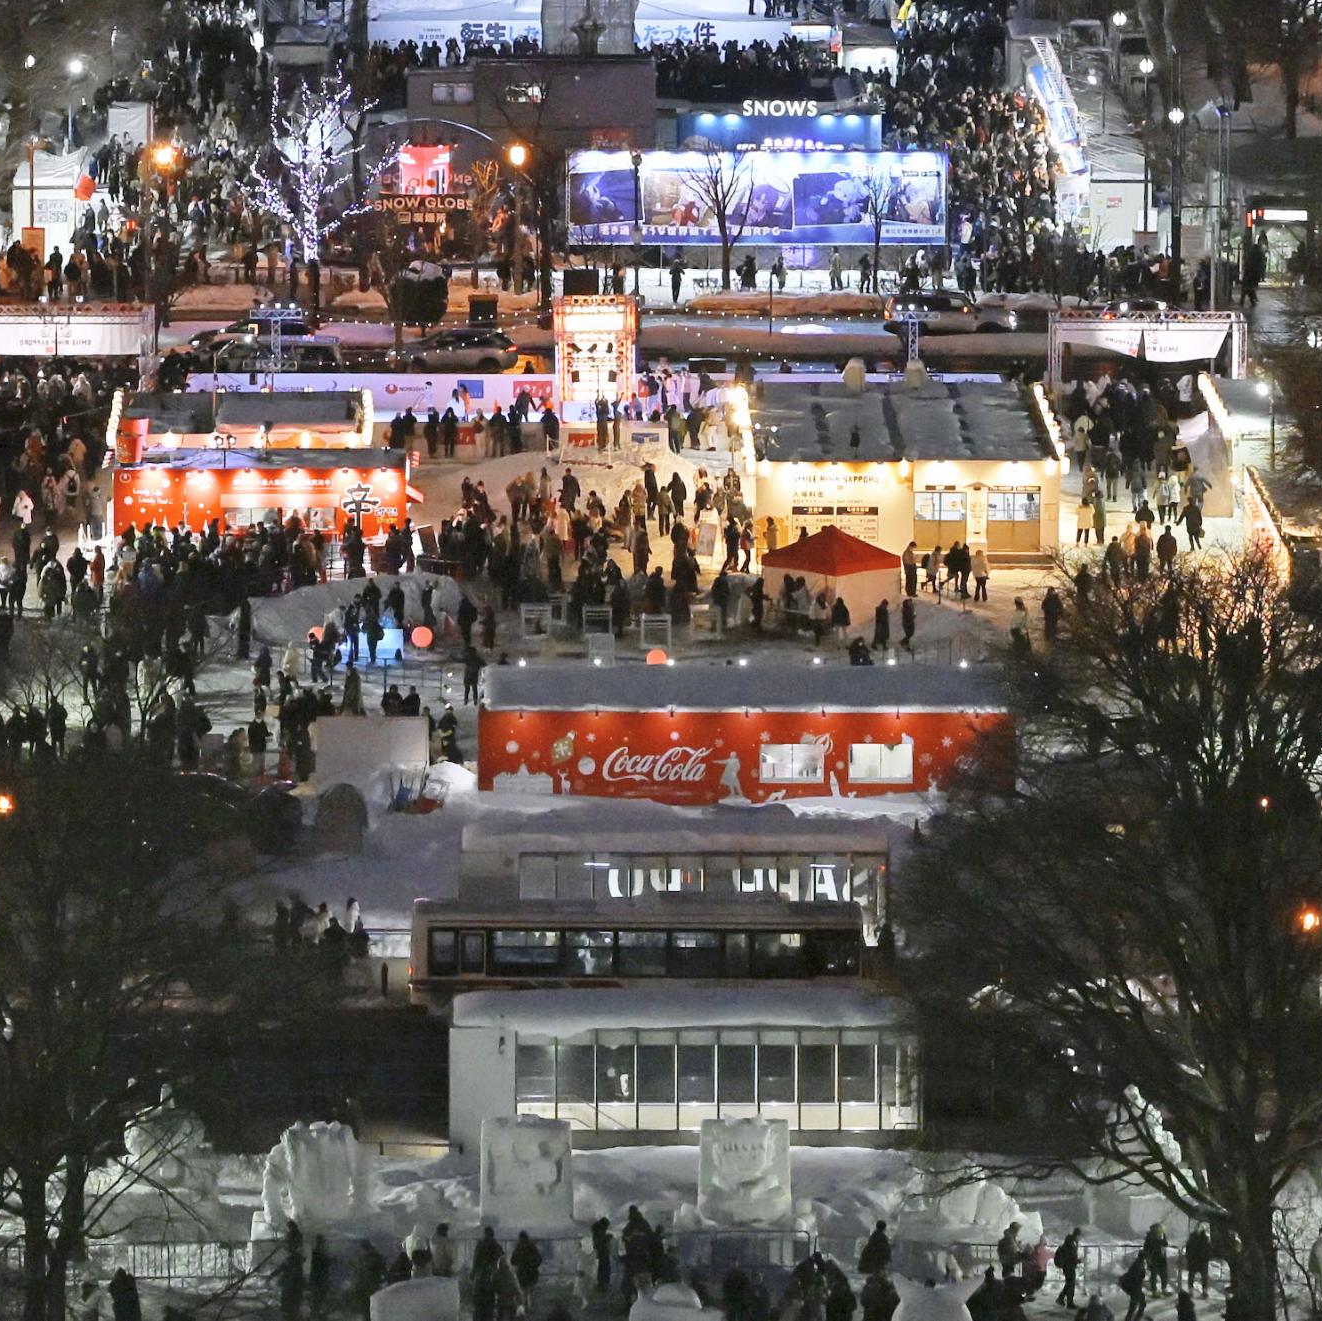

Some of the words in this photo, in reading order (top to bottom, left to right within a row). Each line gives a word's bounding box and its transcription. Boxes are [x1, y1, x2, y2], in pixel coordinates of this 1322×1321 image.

[742, 99, 818, 117] SNOWS
[374, 197, 420, 212] SNOW
[601, 745, 714, 782] Coca-Cola
